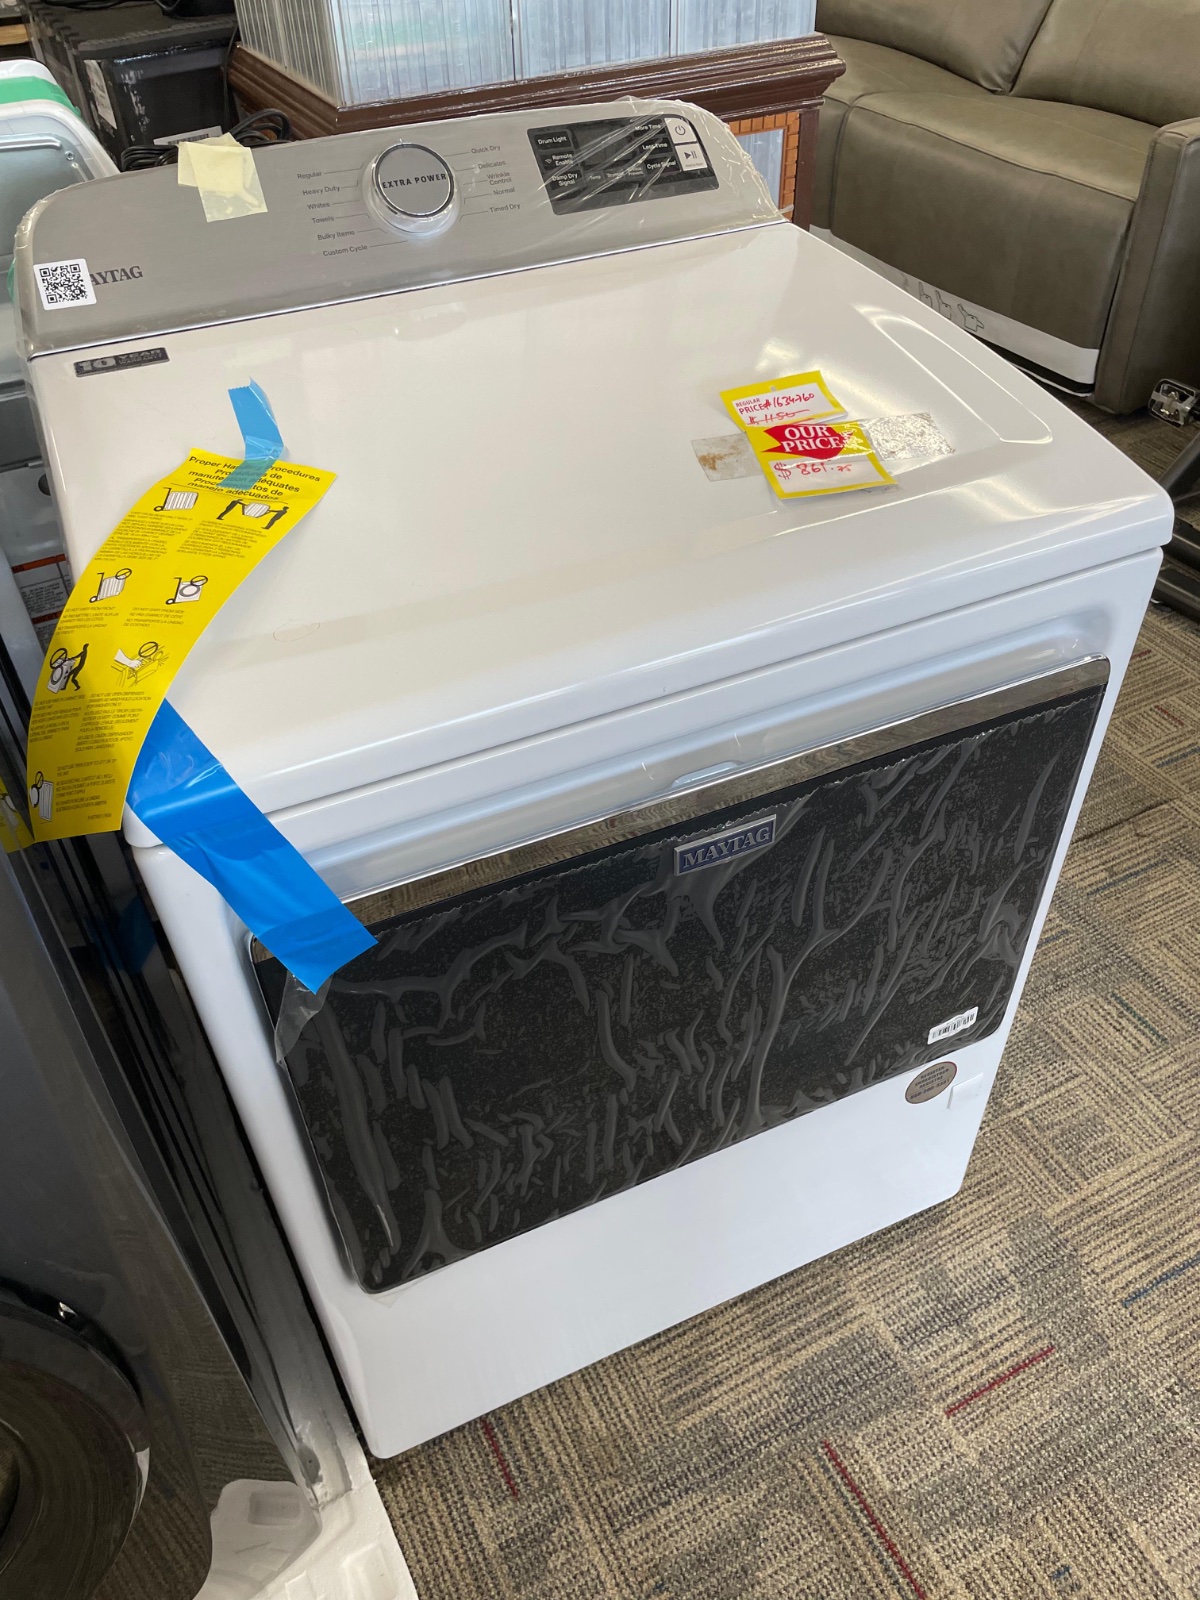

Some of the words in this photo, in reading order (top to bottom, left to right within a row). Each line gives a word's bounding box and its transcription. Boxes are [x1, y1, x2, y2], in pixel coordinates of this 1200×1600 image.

[537, 137, 552, 145] Drum
[552, 135, 567, 144] Light
[471, 146, 488, 154] Quick
[488, 144, 501, 153] Dry
[552, 153, 573, 161] Remote
[478, 160, 506, 170] Delicates
[646, 162, 660, 170] Cycle
[297, 171, 322, 180] Regular
[486, 171, 510, 180] Wrinkle
[552, 175, 567, 183] Damp
[567, 173, 578, 181] Dry
[382, 178, 412, 189] EXTRA
[415, 173, 447, 185] POWER
[489, 177, 512, 186] Control
[558, 179, 576, 187] Signal
[302, 186, 323, 196] Heavy
[324, 185, 341, 194] Duty
[493, 187, 515, 196] Normal
[307, 201, 330, 210] Whites
[489, 204, 508, 213] Timed
[508, 203, 521, 212] Dry
[312, 215, 334, 224] Towels
[317, 233, 335, 241] Bulky
[336, 229, 355, 238] Items
[322, 247, 348, 257] Custom
[349, 244, 368, 253] Cycle
[90, 265, 143, 286] AYTAG
[78, 357, 116, 371] 10
[735, 398, 760, 408] REGULAR
[739, 404, 764, 415] PRICE
[785, 425, 831, 440] OUR
[781, 436, 844, 452] PRICE
[188, 456, 221, 467] Proper
[187, 481, 224, 492] manejo
[225, 489, 279, 500] adecuados
[270, 488, 283, 496] de
[683, 827, 770, 869] MAYTAG
